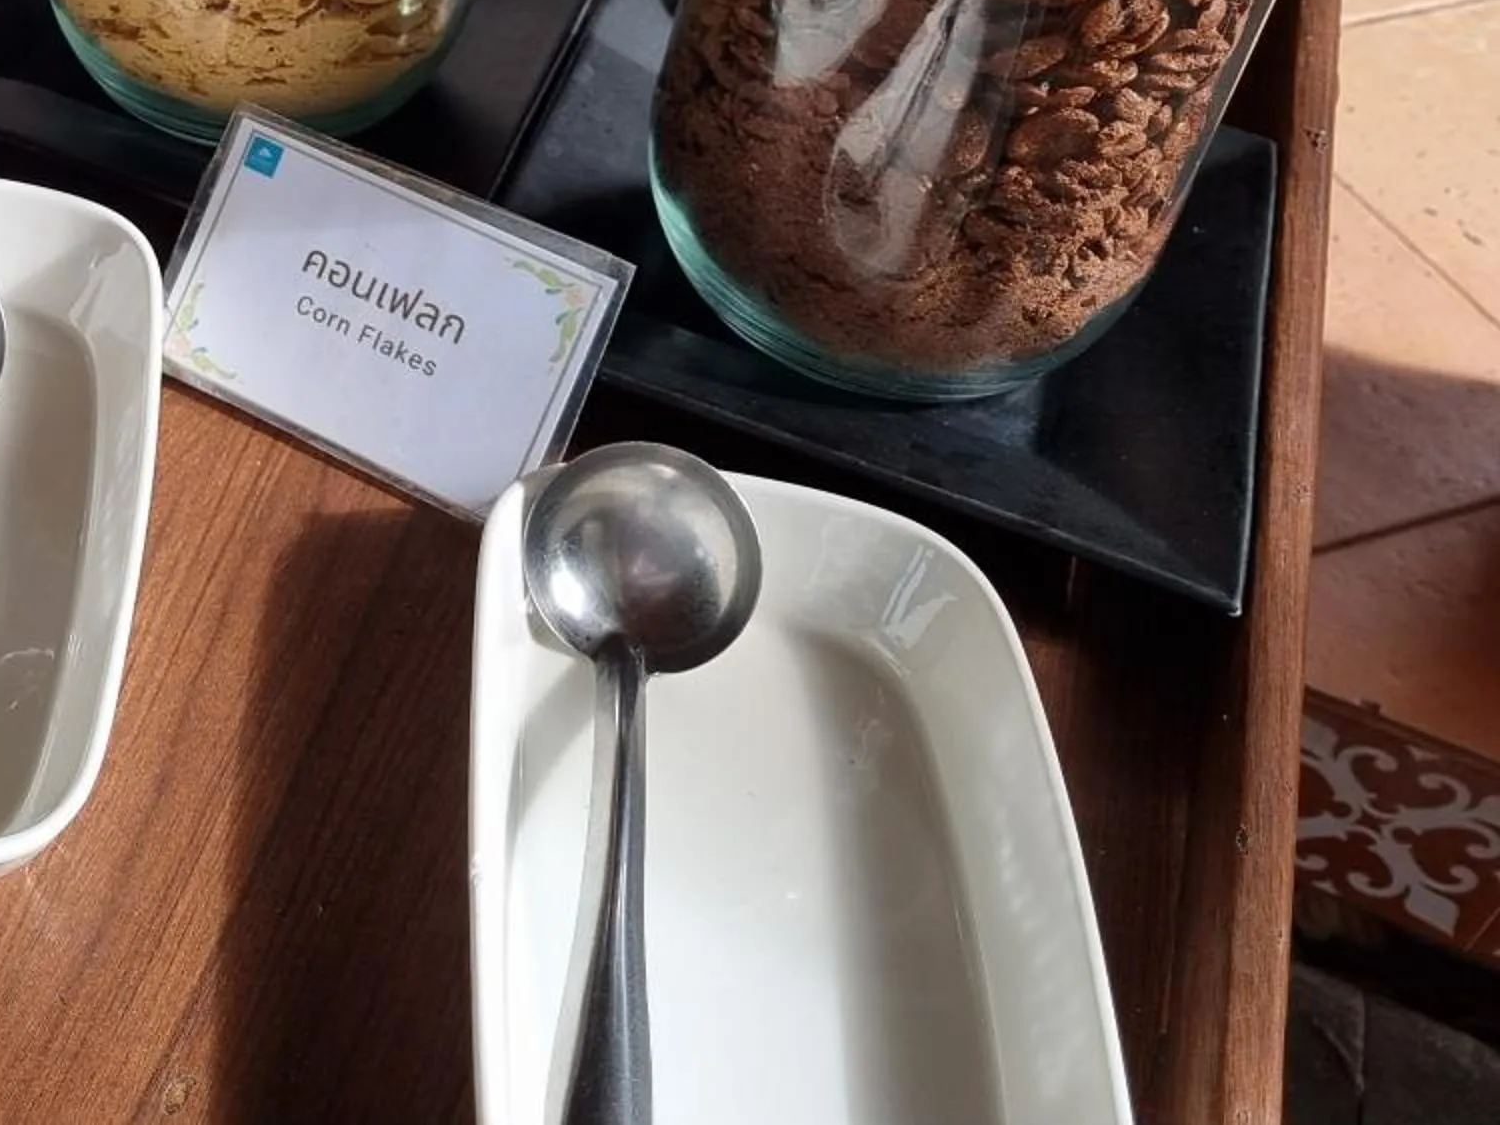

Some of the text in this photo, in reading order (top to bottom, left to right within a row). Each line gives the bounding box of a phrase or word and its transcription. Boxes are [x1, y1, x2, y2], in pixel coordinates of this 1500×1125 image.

[296, 295, 438, 377] Corn Flakes
[301, 249, 466, 345] คอนเฟลก
